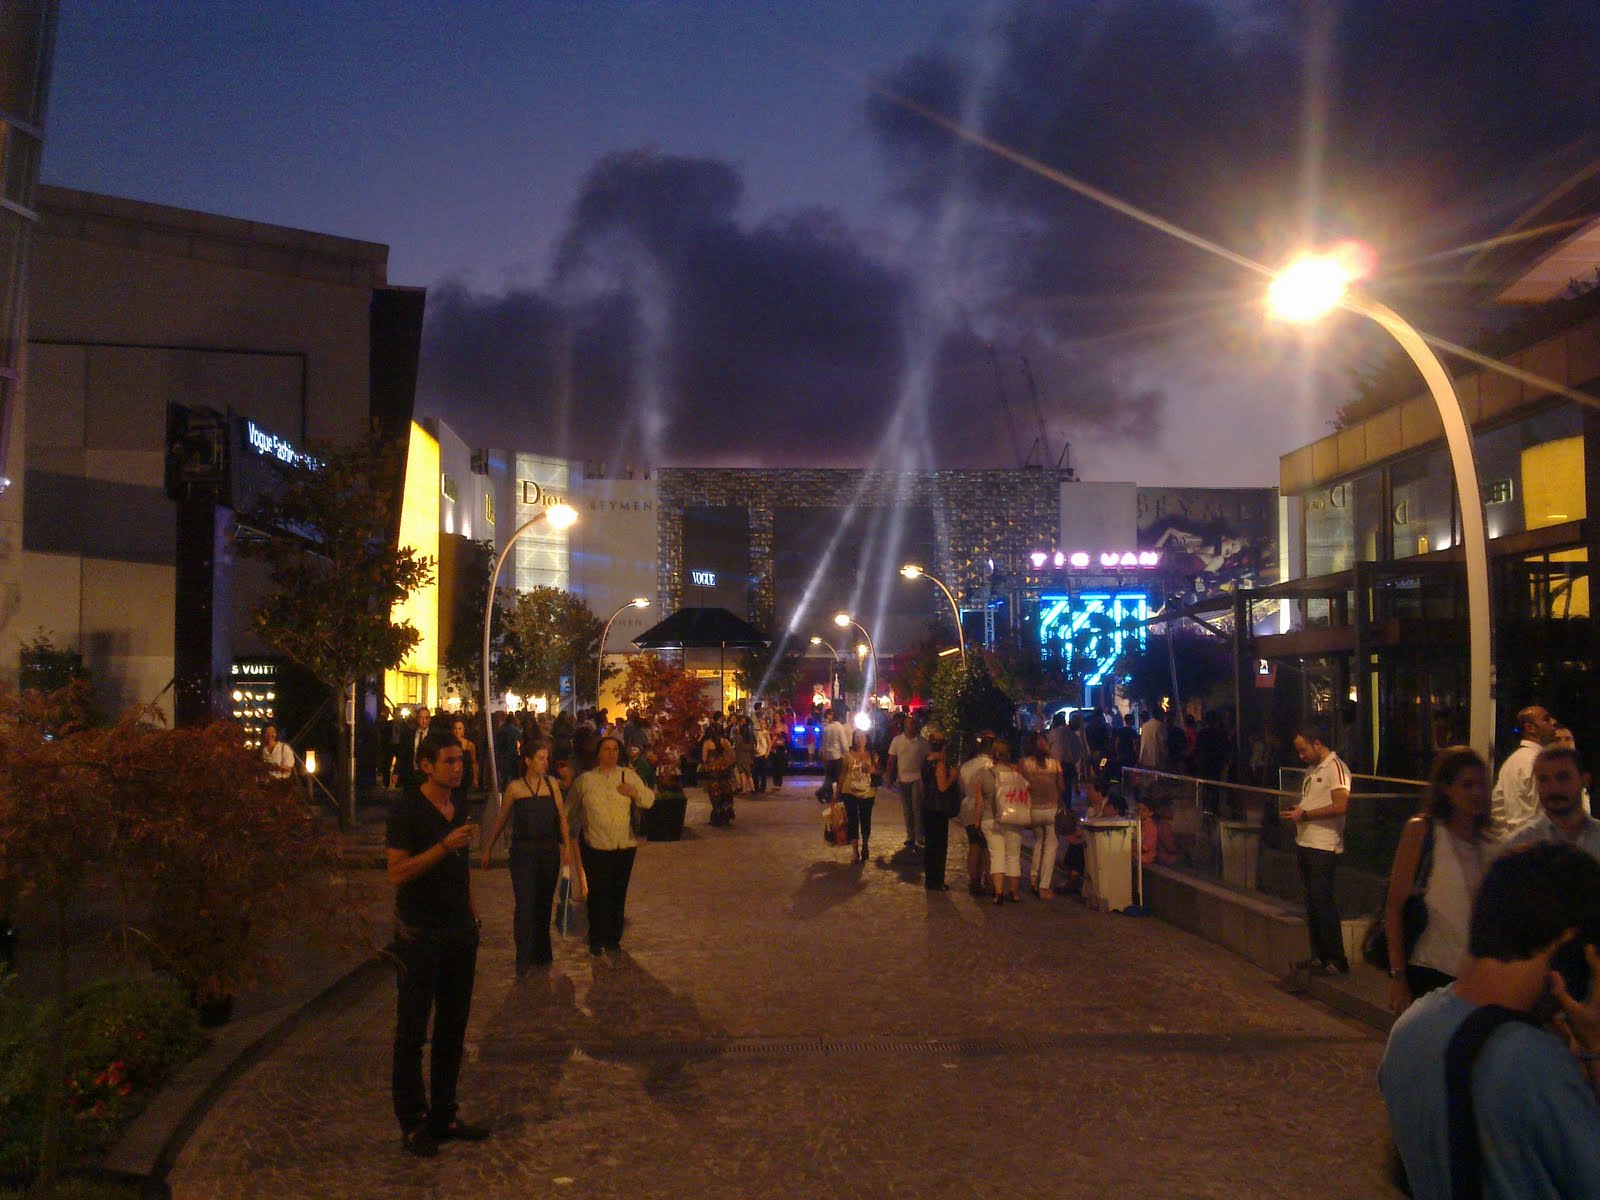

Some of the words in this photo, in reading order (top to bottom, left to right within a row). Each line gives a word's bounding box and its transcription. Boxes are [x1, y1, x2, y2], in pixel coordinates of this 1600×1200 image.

[248, 421, 273, 455] Vogue
[520, 480, 567, 508] Dior
[1030, 552, 1159, 567] TIGUAN
[692, 571, 716, 586] VOGUE
